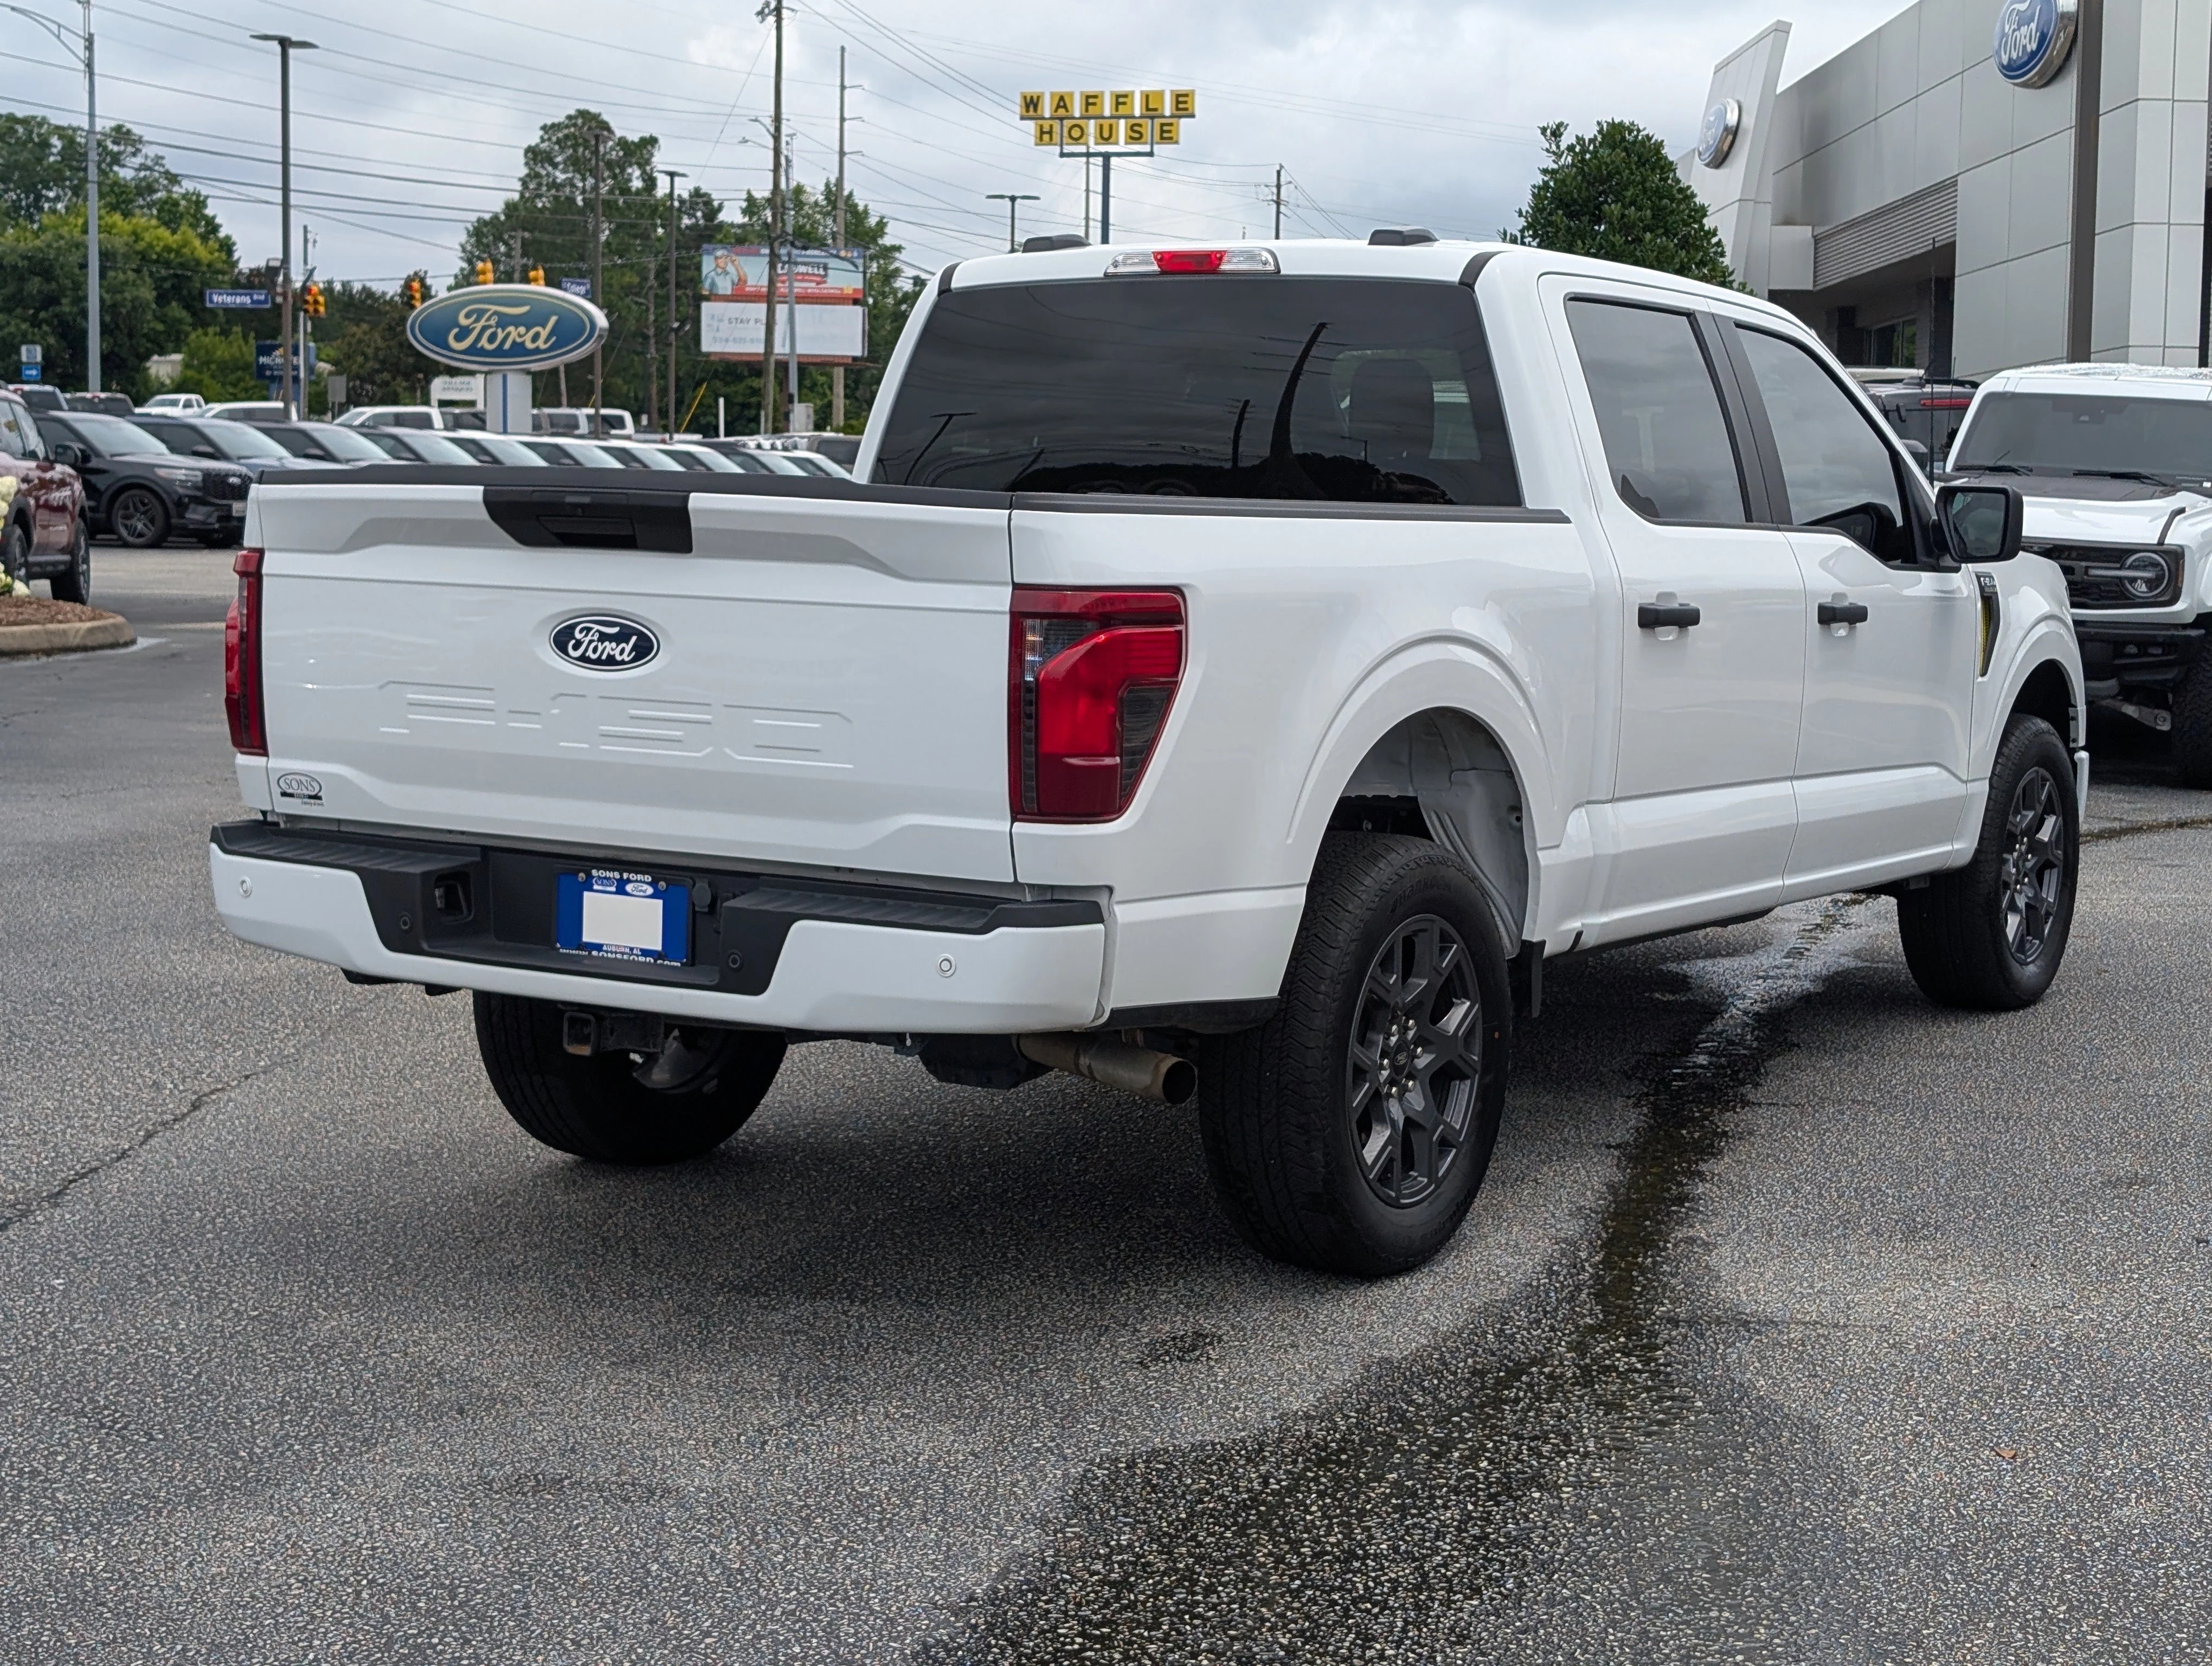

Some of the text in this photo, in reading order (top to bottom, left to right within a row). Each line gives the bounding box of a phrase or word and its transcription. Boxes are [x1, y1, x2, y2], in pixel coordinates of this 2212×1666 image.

[2001, 0, 2042, 66] Ford
[1022, 93, 1191, 114] WAFFLE
[1039, 121, 1175, 143] HOUSE
[212, 293, 252, 304] Veterans
[447, 303, 560, 351] Ford
[568, 622, 638, 662] Ford
[284, 777, 316, 793] SONS
[591, 869, 652, 883] SONS FORD
[631, 883, 648, 894] Ford
